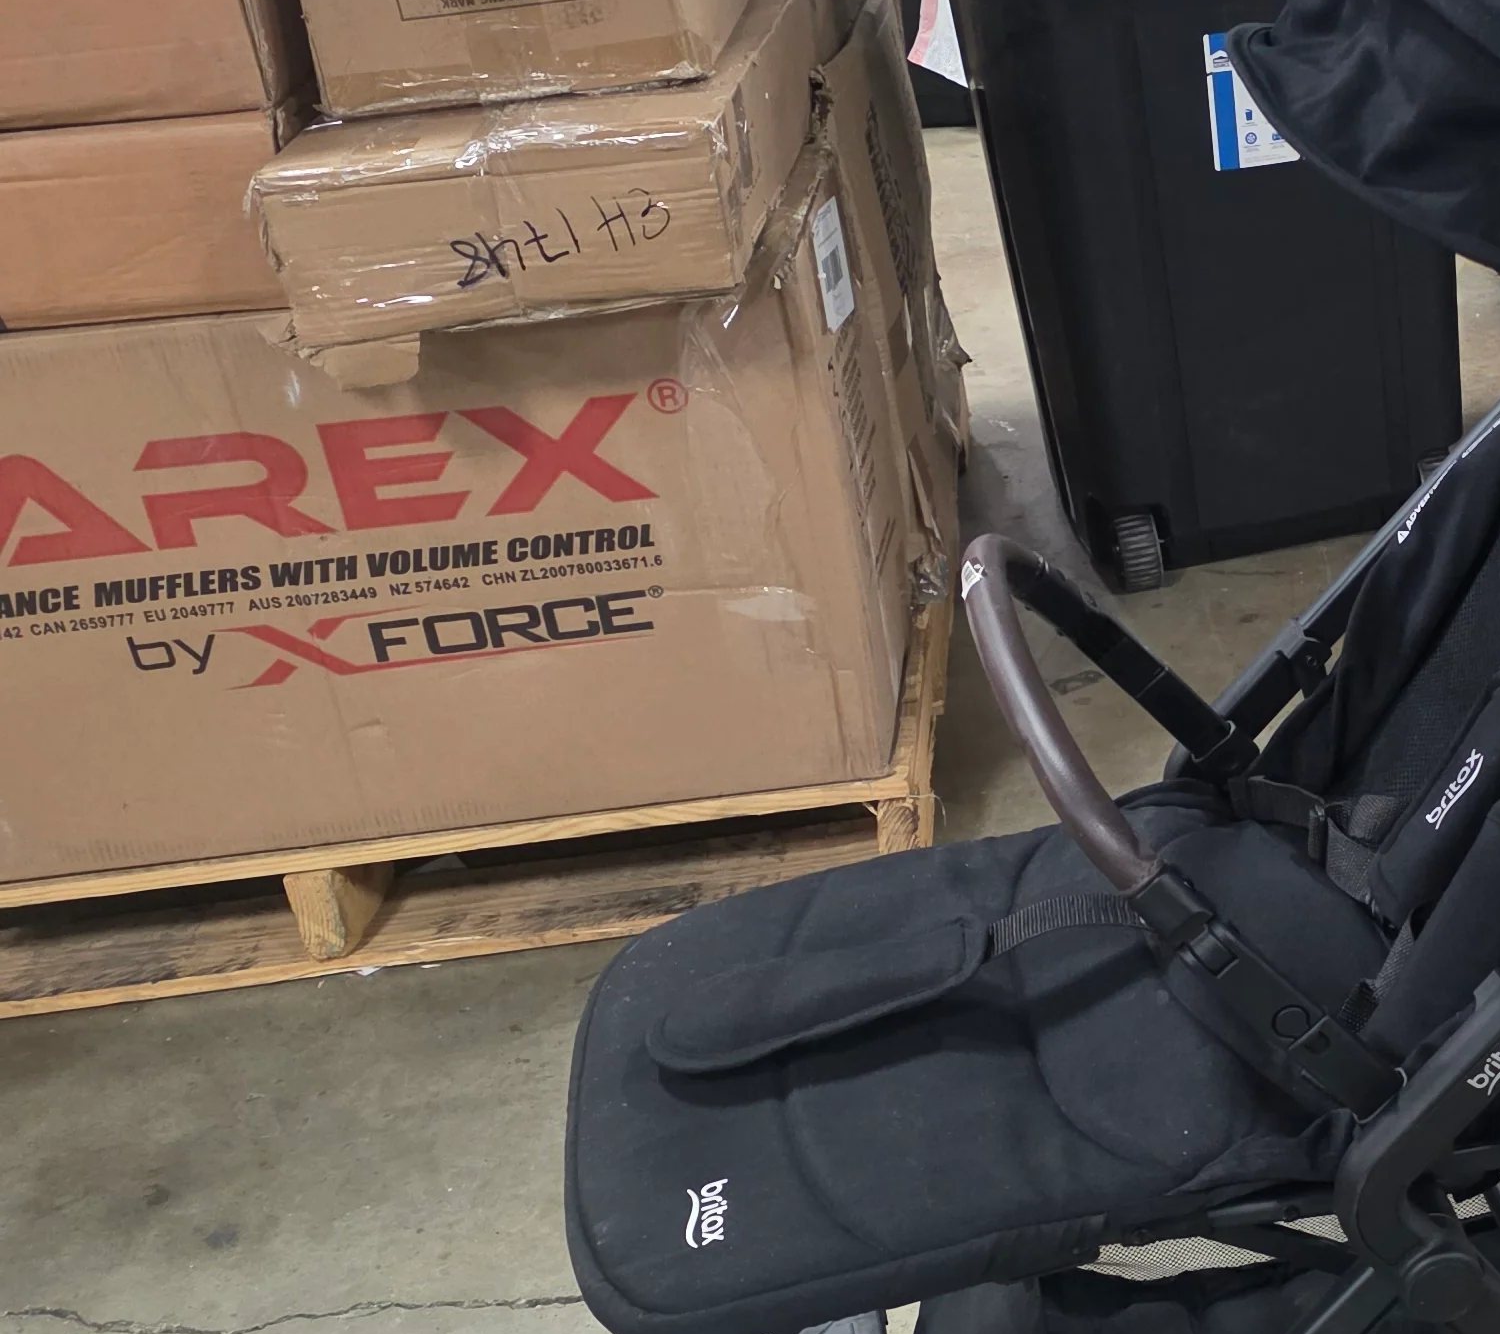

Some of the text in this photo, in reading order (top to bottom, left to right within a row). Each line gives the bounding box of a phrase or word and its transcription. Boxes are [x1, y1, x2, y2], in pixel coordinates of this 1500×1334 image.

[30, 620, 66, 636] CAN
[70, 612, 134, 632] 2659777
[144, 609, 167, 624] EU
[170, 601, 235, 621] 2049777
[249, 596, 282, 612] AUS
[285, 586, 377, 608] 2007283449
[389, 582, 412, 596] NZ
[415, 576, 470, 593] 574642
[482, 571, 517, 586] CHN
[520, 554, 664, 582] ZL200780033671.6
[94, 565, 261, 608] MUFFLERS
[269, 555, 358, 588] WITH
[366, 540, 498, 578] VOLUME
[507, 523, 655, 563] CONTROL
[126, 633, 215, 675] by
[1425, 749, 1481, 823] britax
[700, 1178, 728, 1246] britax
